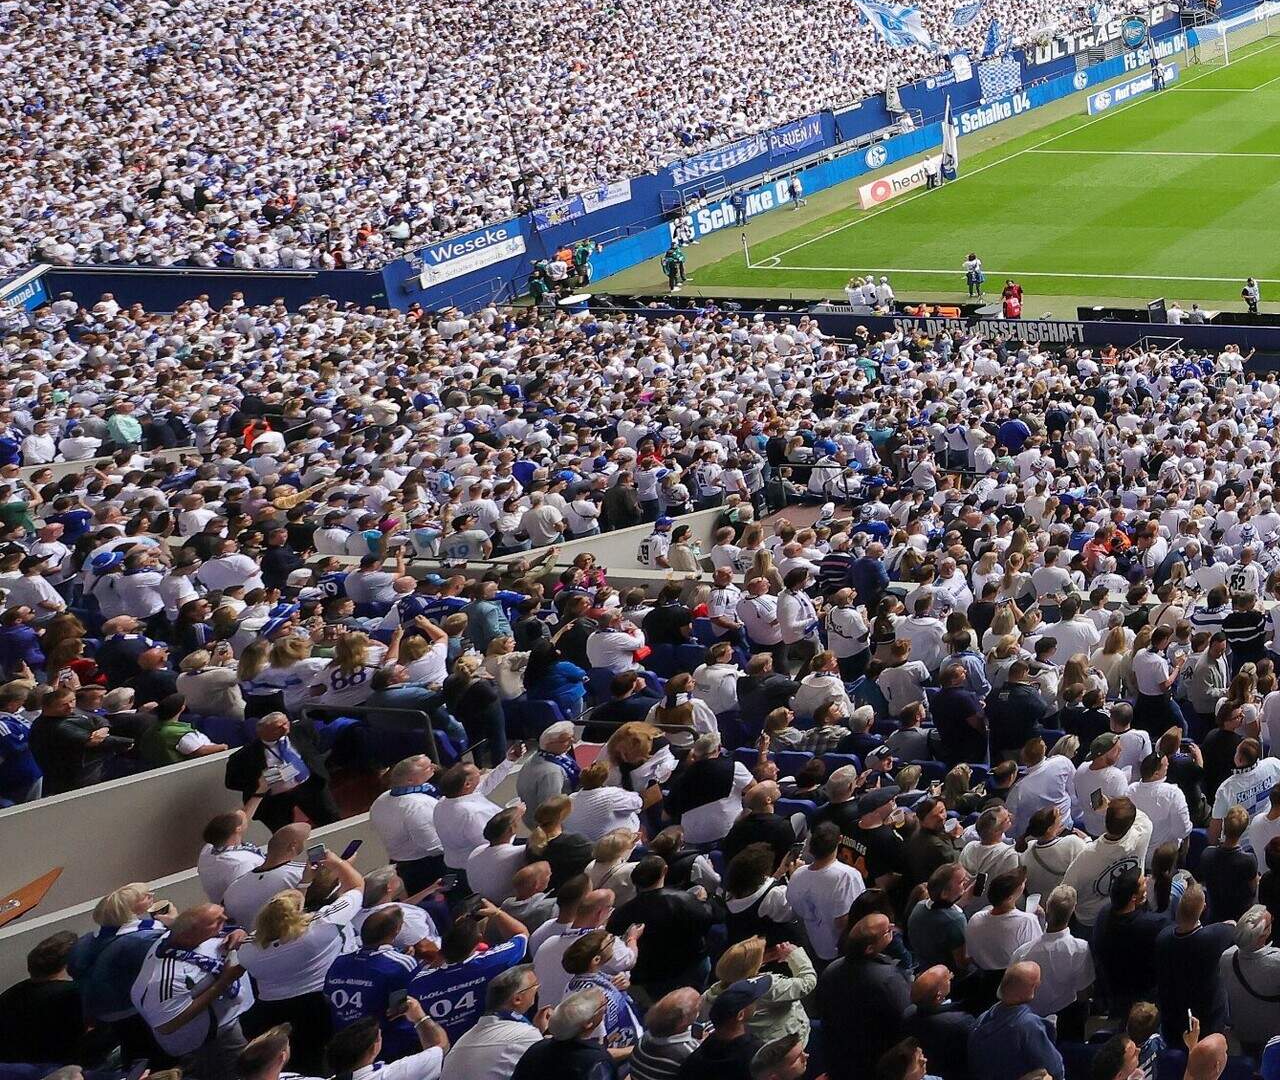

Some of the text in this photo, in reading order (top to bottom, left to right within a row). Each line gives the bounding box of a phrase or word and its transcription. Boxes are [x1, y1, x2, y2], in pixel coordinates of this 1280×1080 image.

[1124, 54, 1137, 71] FC
[961, 92, 1031, 134] Schalke 04
[770, 127, 803, 148] PLAUEN
[892, 166, 928, 193] heat
[431, 228, 508, 263] Weseke
[330, 668, 366, 690] 88
[1237, 782, 1264, 803] SCHALKE
[331, 990, 362, 1008] 04
[430, 990, 477, 1018] 04
